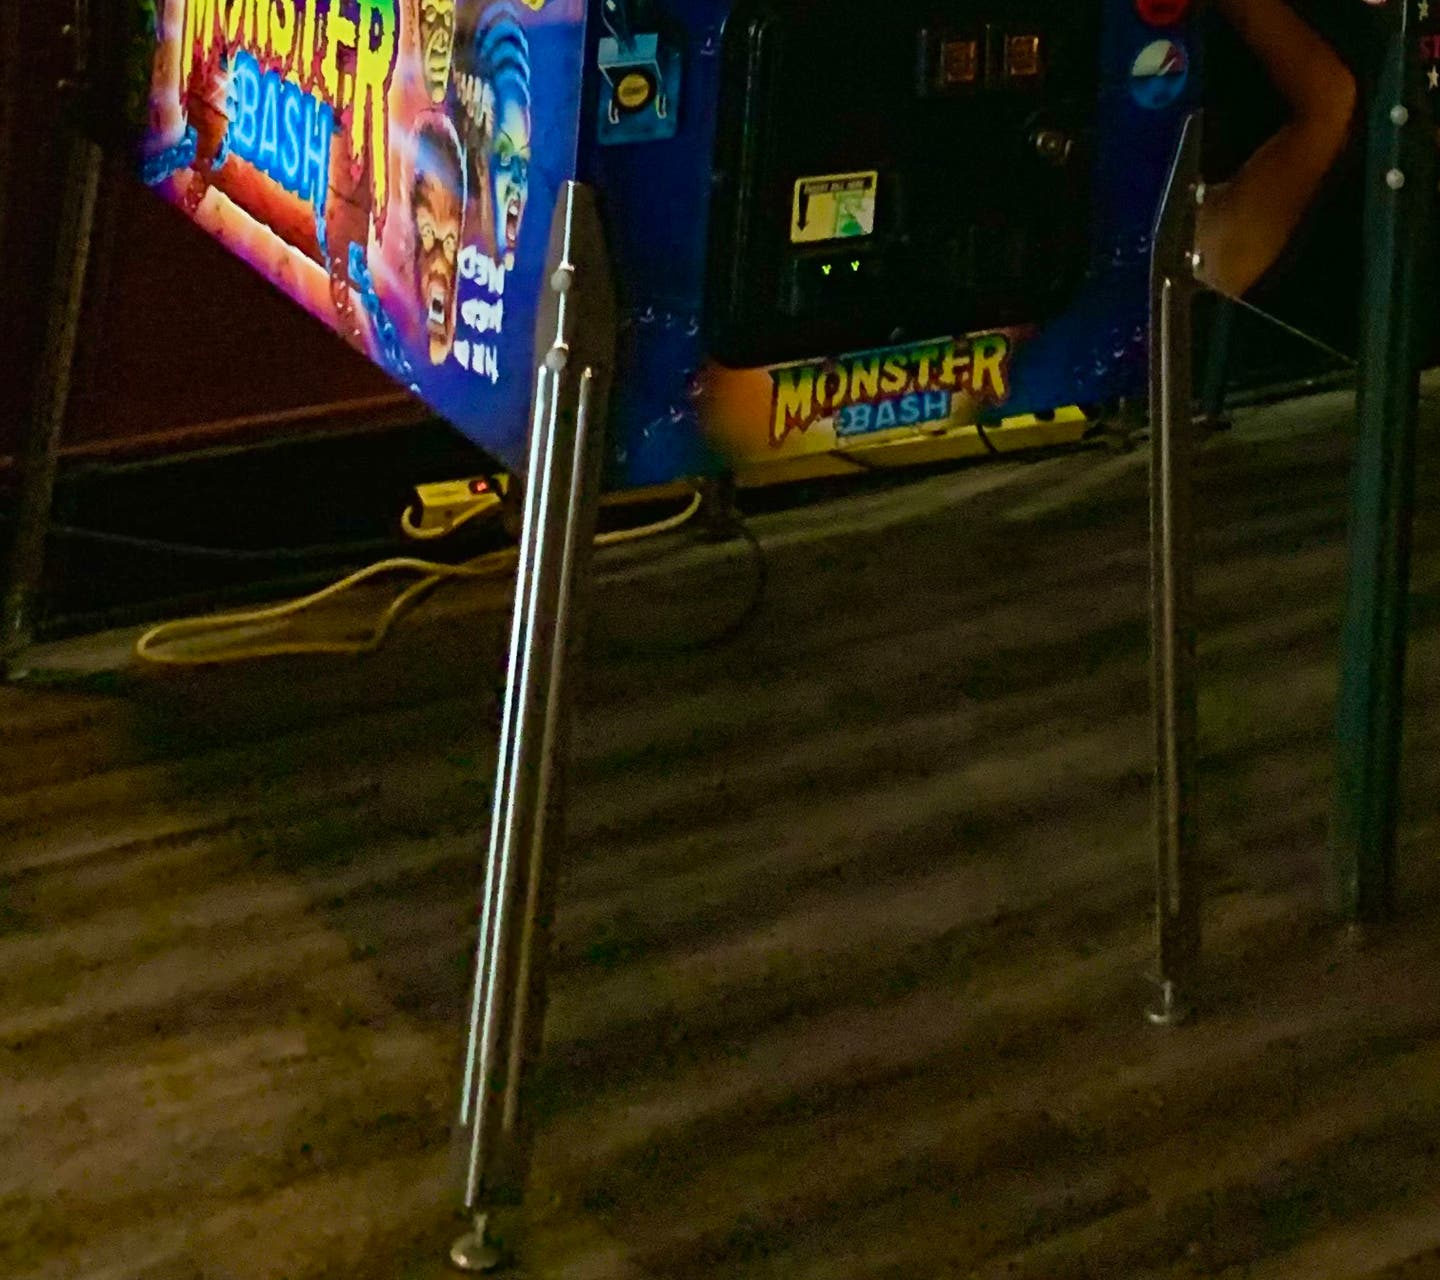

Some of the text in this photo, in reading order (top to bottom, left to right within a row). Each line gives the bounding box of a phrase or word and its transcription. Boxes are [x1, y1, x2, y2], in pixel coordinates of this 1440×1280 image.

[231, 53, 332, 202] BASH
[773, 332, 1007, 441] MONSTER
[843, 391, 949, 435] BASH
